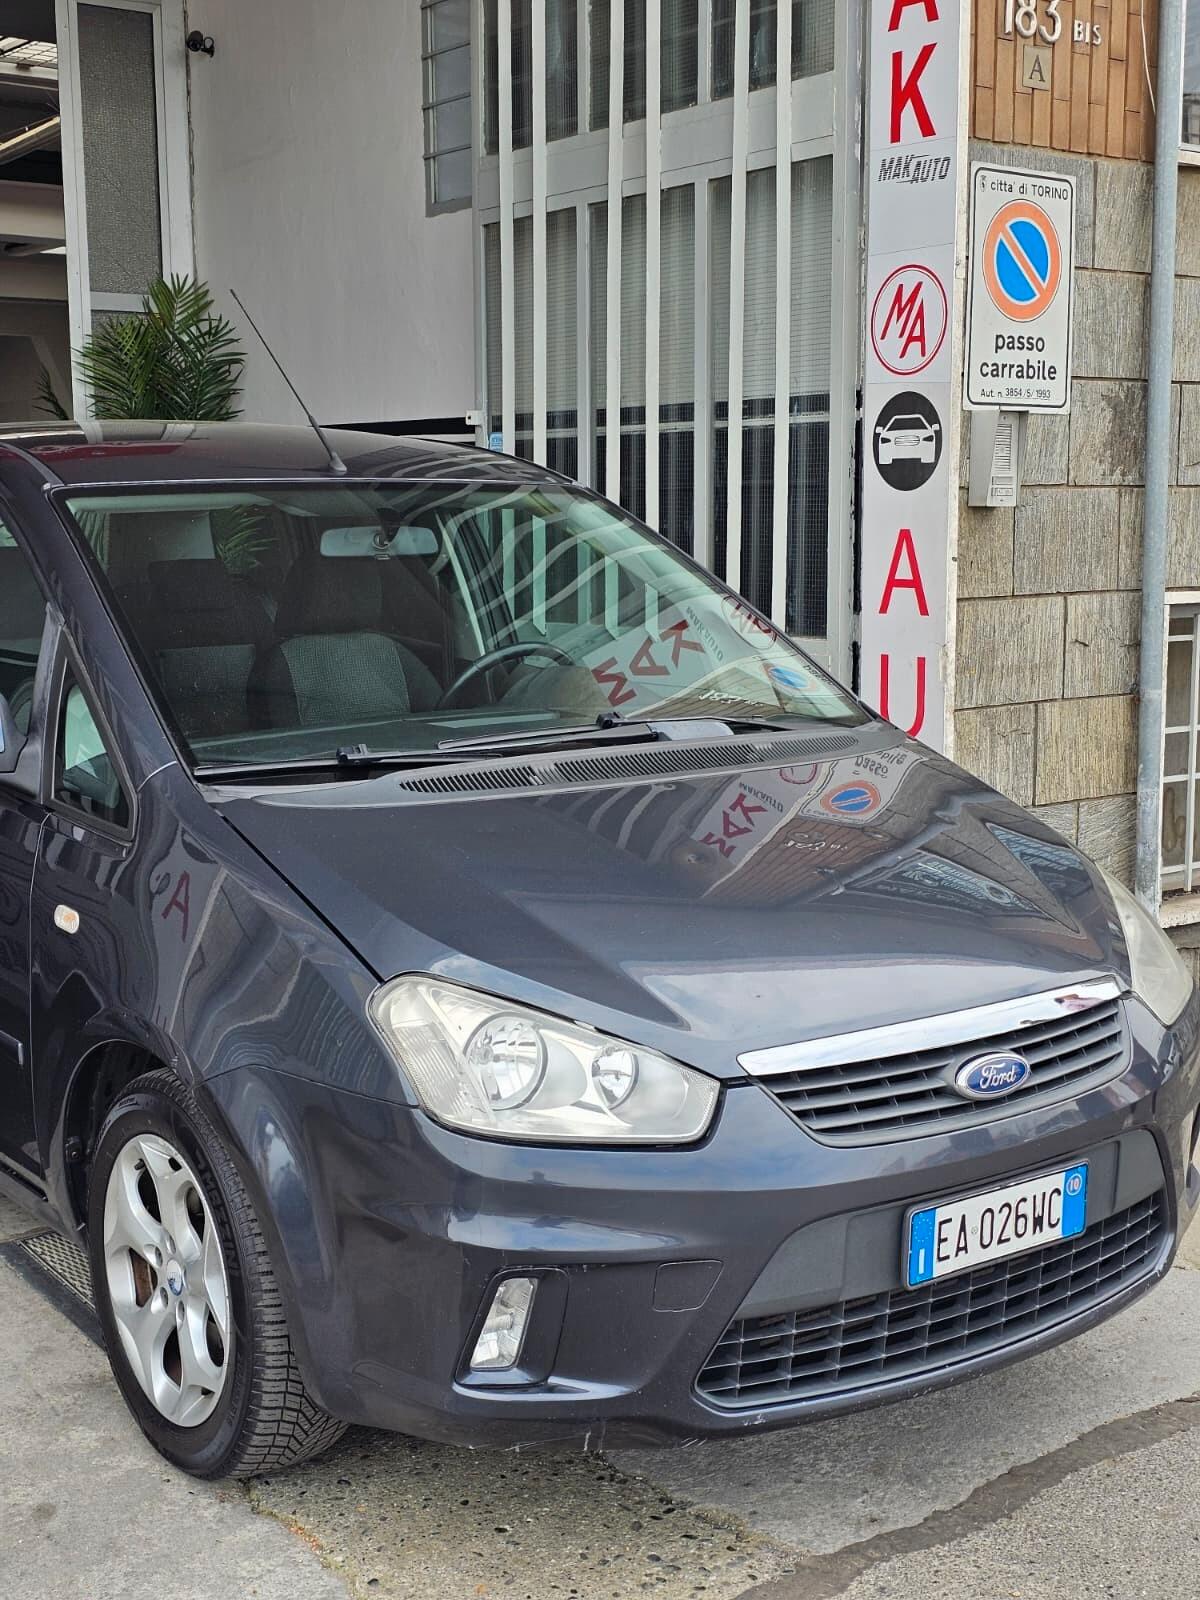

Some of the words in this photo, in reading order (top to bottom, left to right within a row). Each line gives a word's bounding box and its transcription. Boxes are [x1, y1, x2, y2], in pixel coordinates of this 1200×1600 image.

[1004, 0, 1061, 43] 183
[1073, 20, 1102, 46] BIS
[1028, 54, 1045, 82] A
[1018, 183, 1028, 195] di
[1031, 183, 1069, 201] TORINO
[880, 281, 926, 359] MA
[995, 334, 1045, 354] passo
[979, 359, 1057, 381] carrabile
[980, 1062, 1017, 1089] Ford
[936, 1187, 1062, 1262] EA026WC
